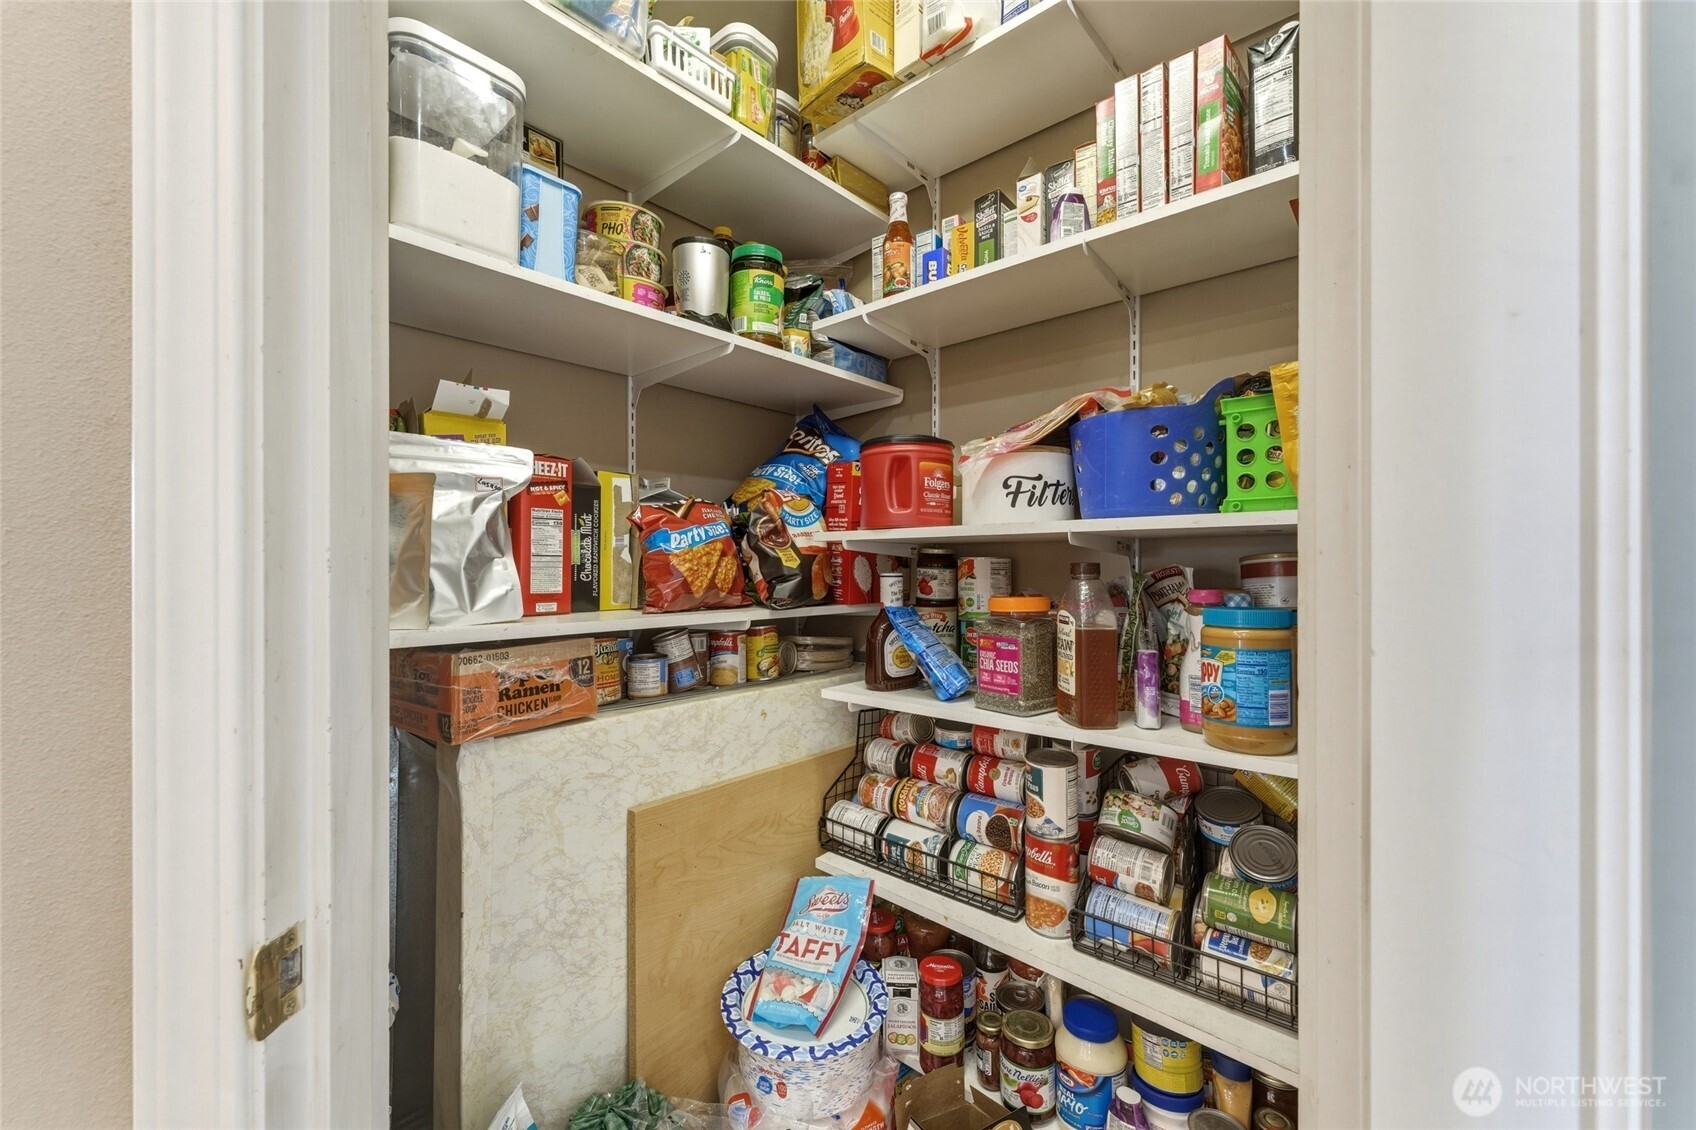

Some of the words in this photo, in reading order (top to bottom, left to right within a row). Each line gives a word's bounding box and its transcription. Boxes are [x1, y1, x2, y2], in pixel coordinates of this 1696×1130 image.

[602, 222, 624, 235] PHO
[957, 227, 968, 261] Velveeta
[754, 276, 773, 285] Knorr
[790, 427, 840, 464] oritos
[924, 477, 950, 490] Folgers
[580, 513, 592, 535] Mint
[785, 514, 804, 526] PARTY
[804, 511, 819, 524] SIZE
[671, 526, 705, 549] Party
[705, 522, 728, 536] Size!
[580, 535, 592, 582] Chocolate
[458, 651, 510, 666] 70662-01503
[980, 651, 996, 659] ORGANIC
[577, 657, 591, 674] 12
[980, 657, 994, 671] CHIA
[996, 661, 1019, 674] SEEDS
[462, 694, 484, 706] NOODLE
[498, 681, 562, 703] Ramen
[497, 697, 548, 717] CHICKEN
[441, 717, 451, 731] 12
[1032, 879, 1050, 890] Bacon
[799, 892, 850, 915] Sweet's
[815, 924, 845, 936] WATER
[776, 932, 852, 963] TAFFY
[1057, 1093, 1088, 1115] MAYO
